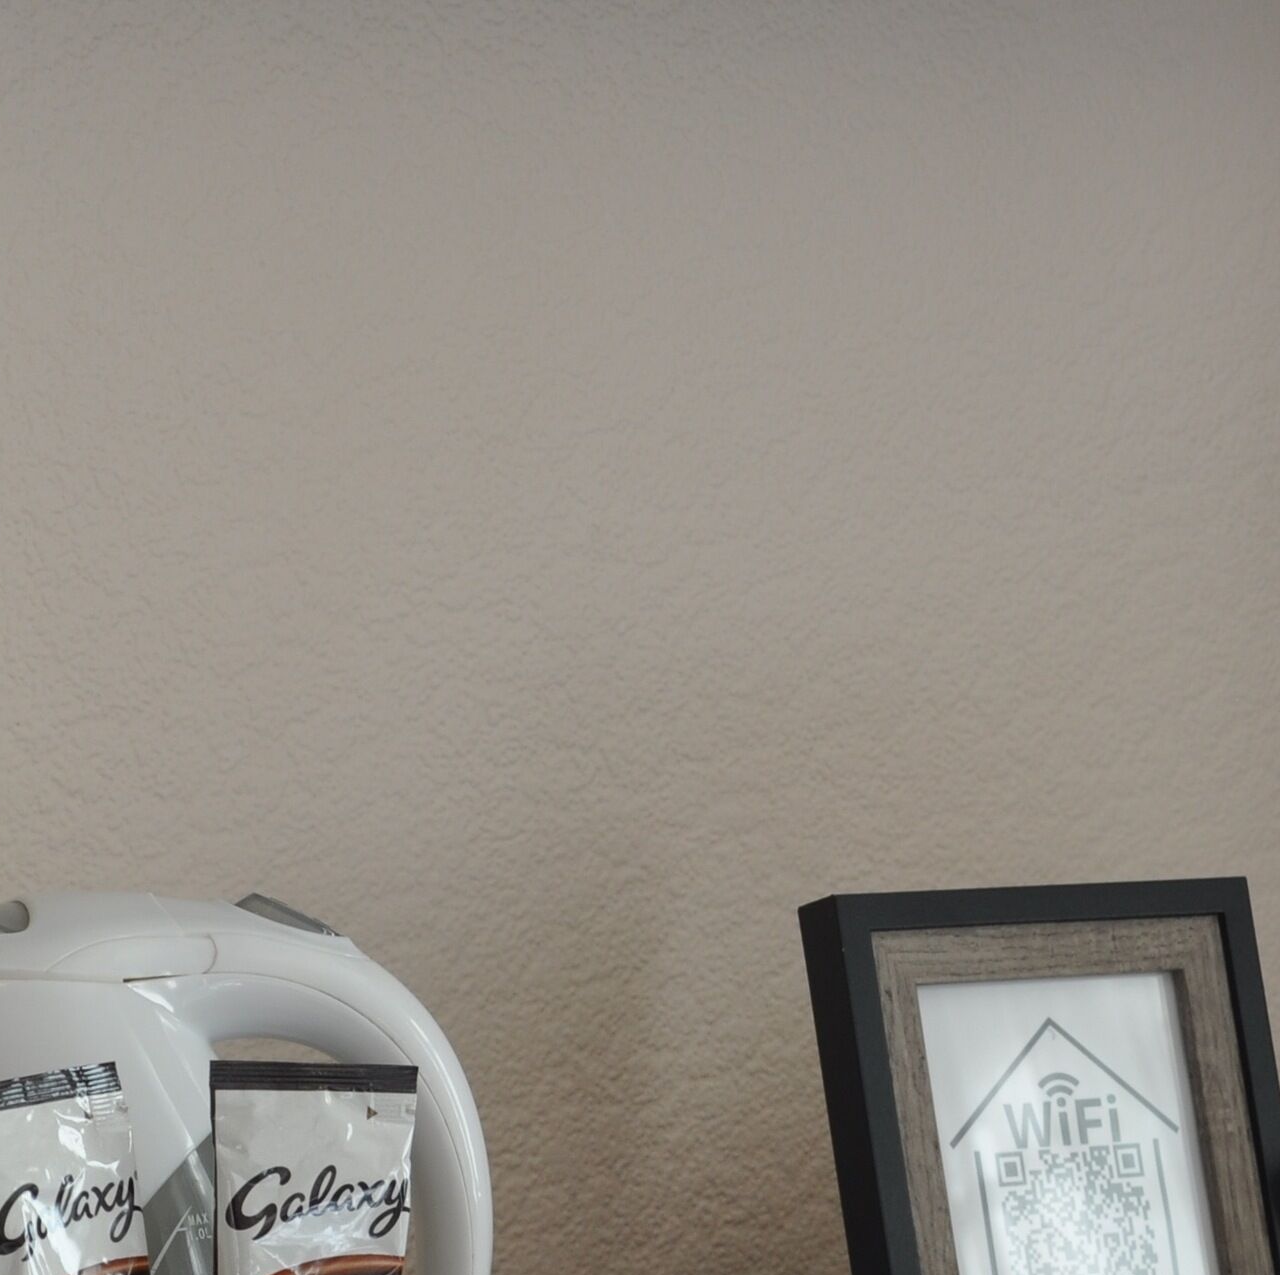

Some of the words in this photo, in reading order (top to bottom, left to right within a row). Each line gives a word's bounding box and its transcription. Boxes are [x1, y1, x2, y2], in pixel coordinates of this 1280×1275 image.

[1004, 1094, 1123, 1150] WiFi
[187, 1211, 209, 1226] MAX
[225, 1164, 410, 1240] Galaxy
